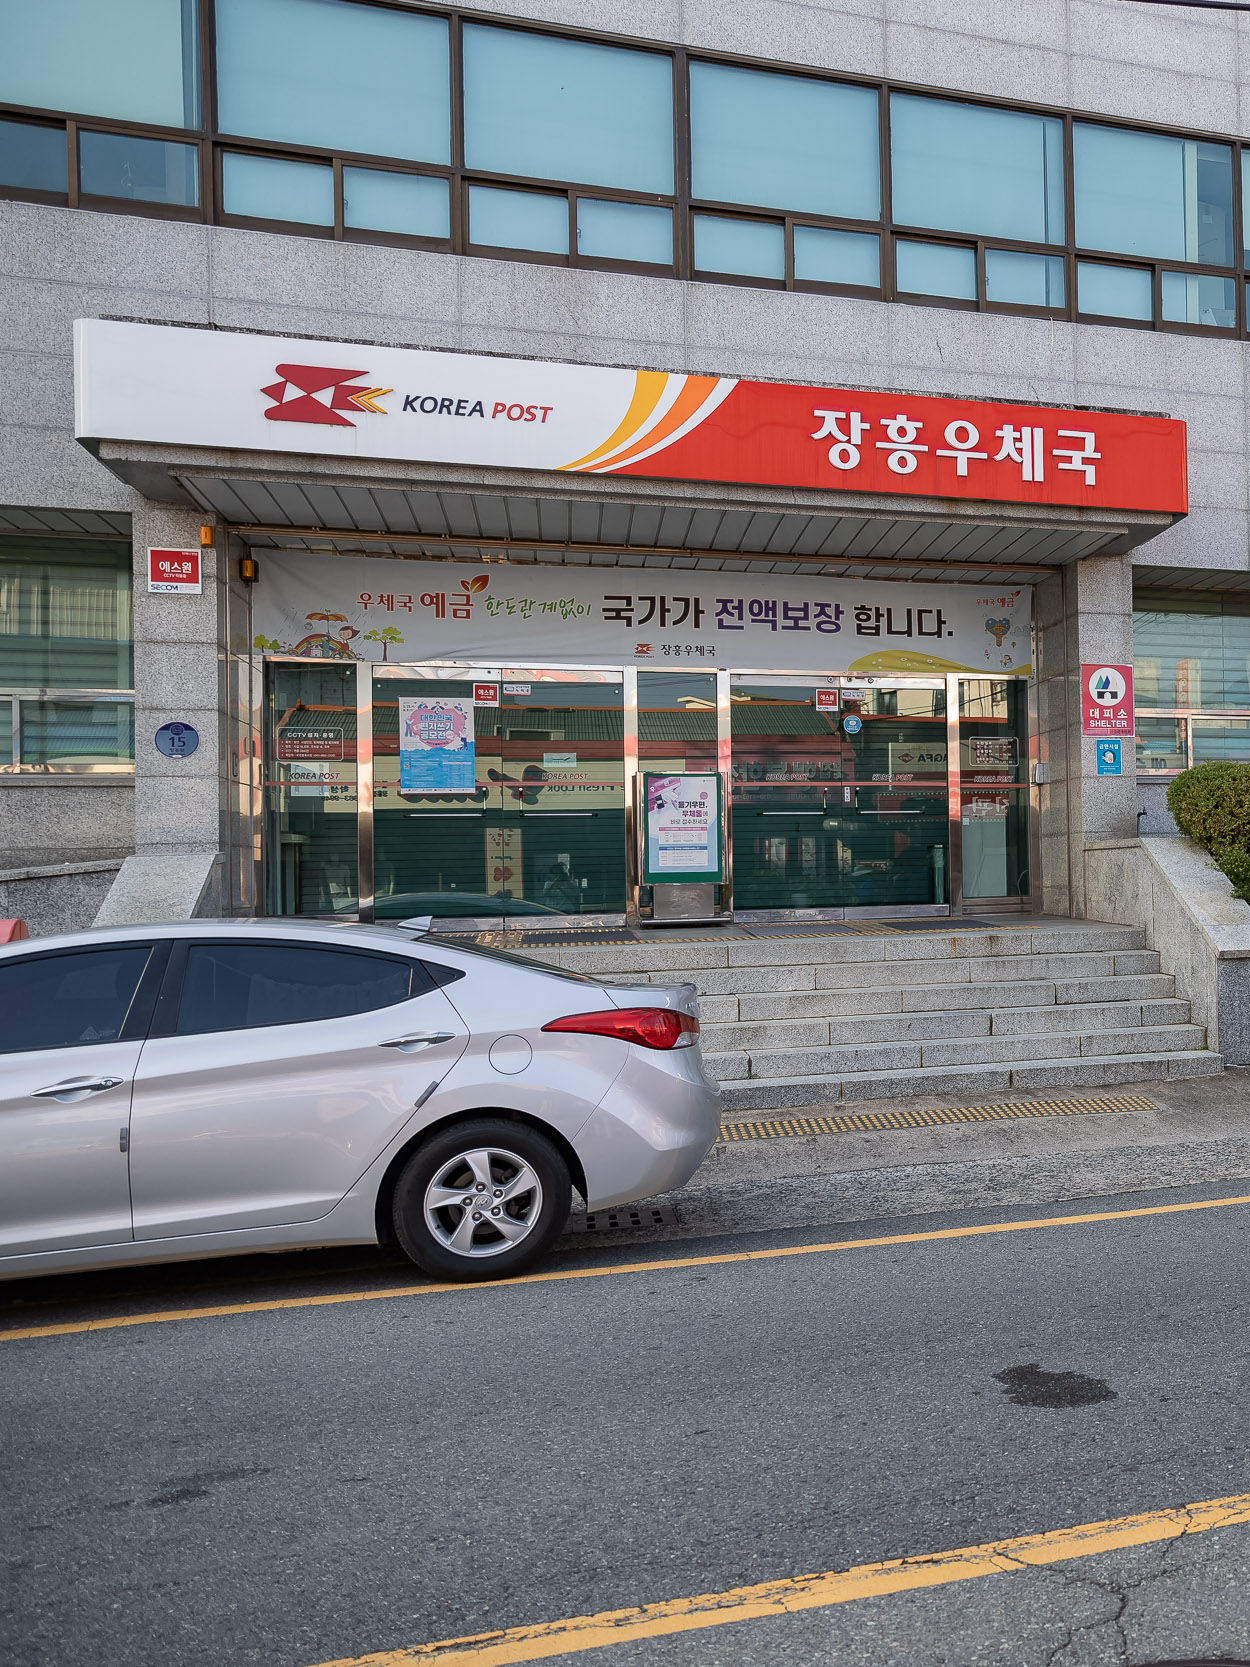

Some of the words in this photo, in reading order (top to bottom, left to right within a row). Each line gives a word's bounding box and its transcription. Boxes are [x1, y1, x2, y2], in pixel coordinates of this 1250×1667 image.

[402, 394, 485, 418] KOREA
[491, 402, 554, 424] POST
[810, 409, 1102, 486] 장흥우체국
[158, 560, 193, 574] 에스원
[356, 592, 415, 613] 우체국
[419, 592, 475, 620] 예금
[601, 595, 706, 629] 국가가
[714, 597, 845, 634] 전액보장
[853, 603, 955, 639] 합니다.
[660, 644, 717, 657] 장흥우체국
[1089, 708, 1128, 719] 대피소
[420, 722, 454, 731] 편지쓰기
[420, 731, 446, 740] 공모전
[168, 736, 186, 748] 15
[288, 772, 317, 780] KOREA
[318, 772, 340, 780] POST
